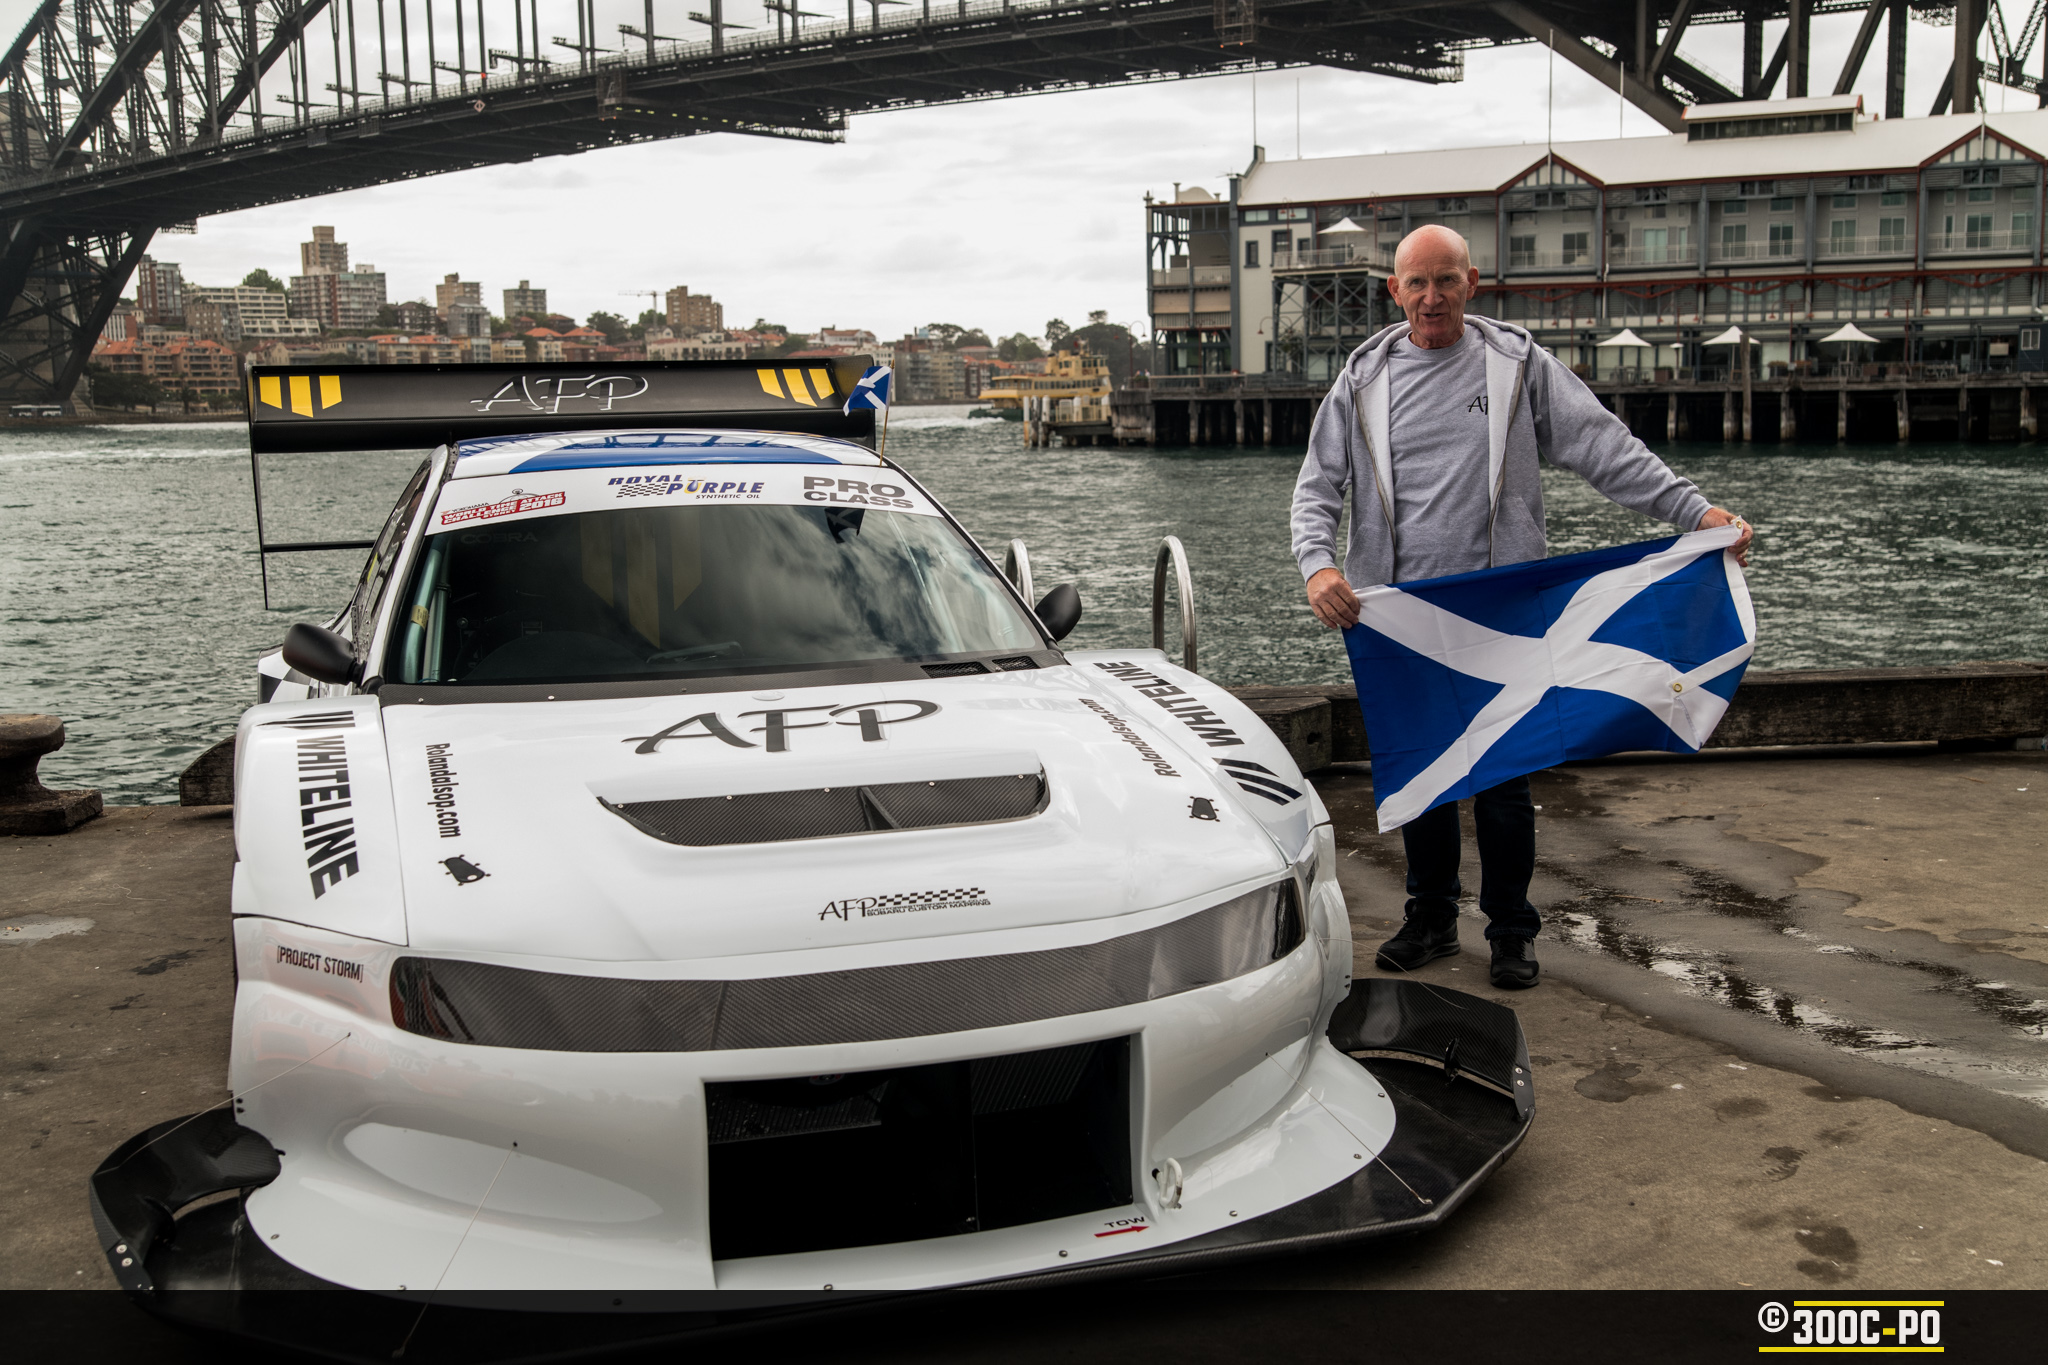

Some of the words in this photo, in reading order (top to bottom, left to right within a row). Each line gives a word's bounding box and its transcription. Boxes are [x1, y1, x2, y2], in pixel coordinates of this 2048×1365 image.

[470, 374, 649, 414] AFP
[608, 475, 683, 486] ROYAL
[666, 478, 764, 495] PURPLE
[804, 476, 905, 498] PRO
[443, 507, 485, 520] WORLD
[490, 500, 517, 511] TIME
[520, 493, 564, 504] ATTACK
[804, 491, 914, 509] CLASS
[444, 505, 517, 525] CHALLENGE
[1093, 661, 1245, 747] WHITELINE
[621, 699, 942, 754] AFP
[426, 743, 461, 838] Rolandalsop.com
[297, 735, 359, 900] WHITELINE
[818, 896, 877, 921] AFP
[867, 907, 906, 917] SUBARU
[908, 904, 948, 913] CUSTOM
[949, 901, 991, 909] MAPPING
[1104, 1216, 1145, 1228] TOW
